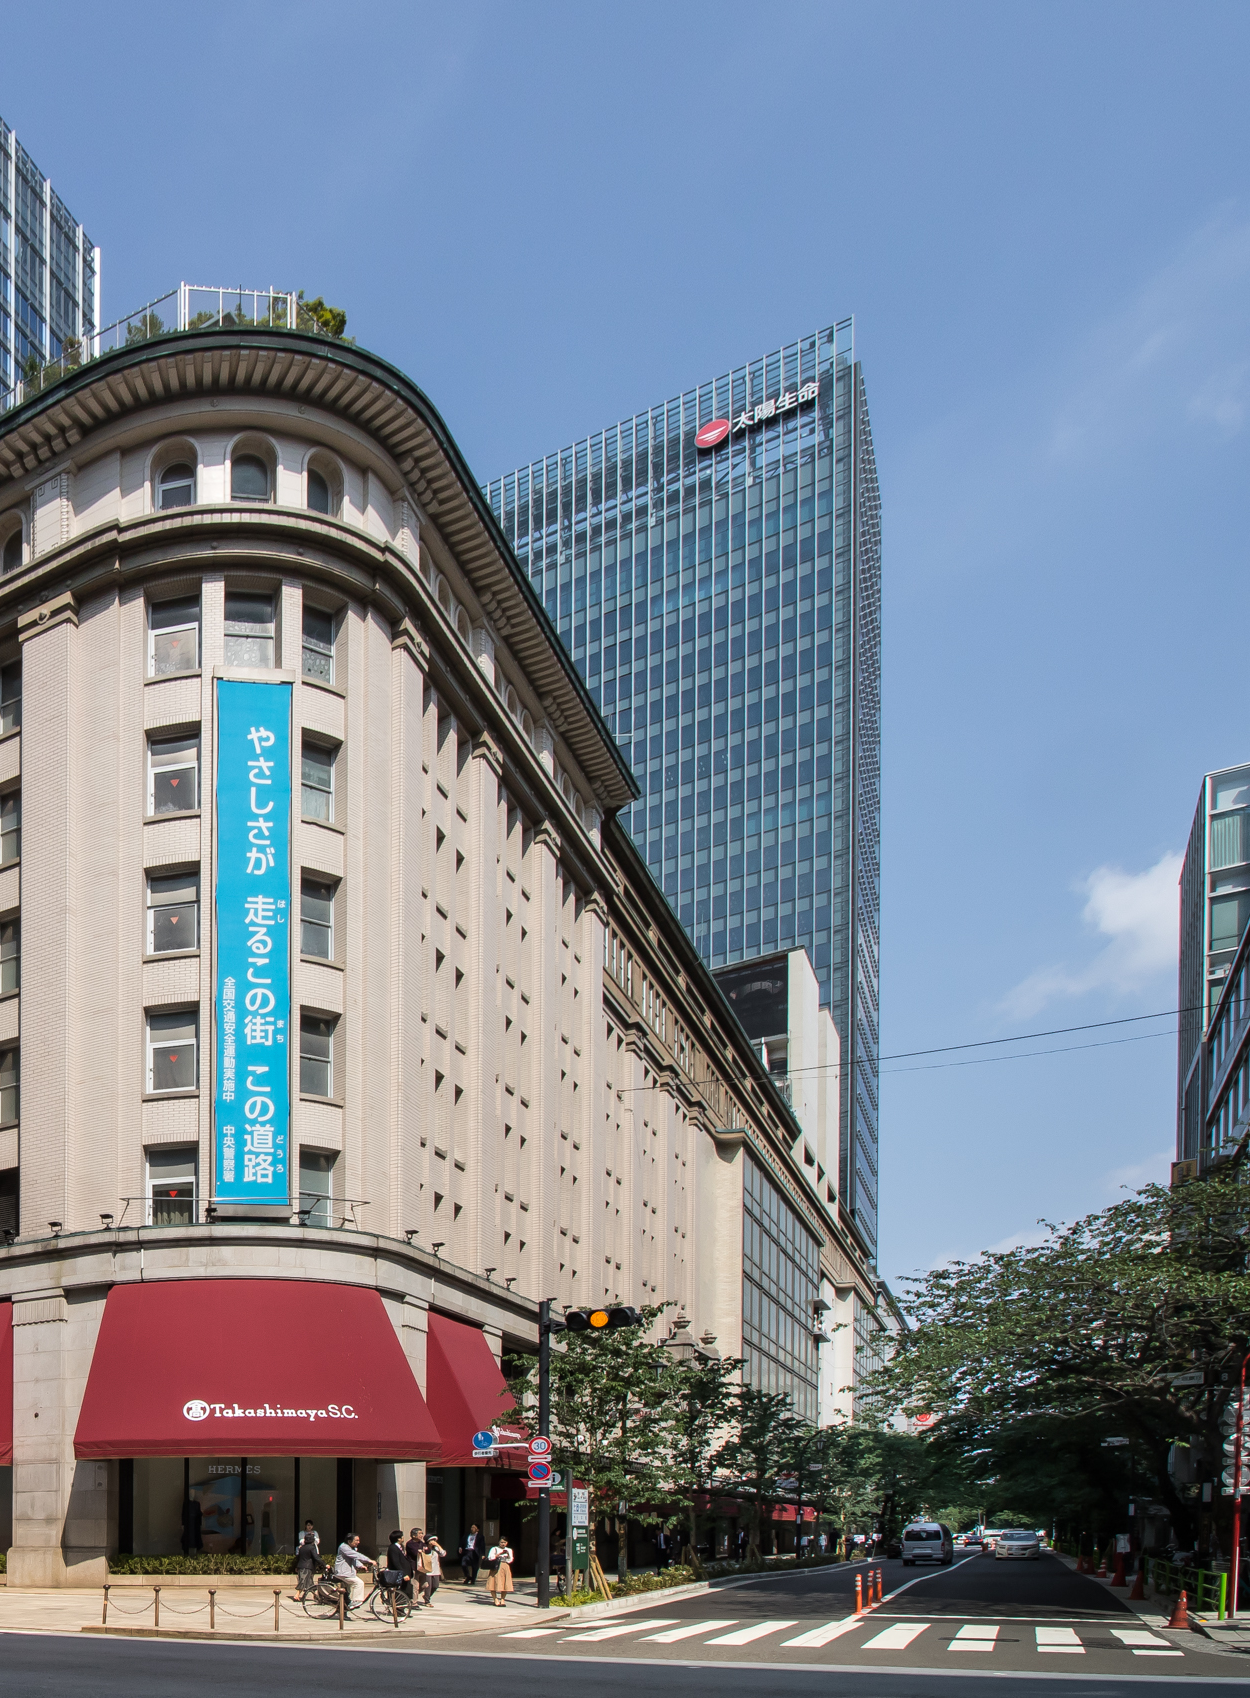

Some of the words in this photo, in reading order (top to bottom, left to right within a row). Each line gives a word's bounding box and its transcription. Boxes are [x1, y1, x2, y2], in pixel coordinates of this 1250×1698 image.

[732, 381, 820, 433] 太陽生命
[246, 726, 275, 876] やさしさが
[277, 899, 286, 923] はし
[244, 894, 276, 1046] 走るこの街
[222, 976, 236, 1103] 全国交通安全運動実施中
[276, 1019, 285, 1043] まち
[243, 1066, 275, 1184] この道路
[222, 1124, 236, 1183] 中央警察署
[276, 1135, 284, 1173] どうろ
[210, 1403, 327, 1422] Takashimaya
[328, 1404, 359, 1419] S.C.
[533, 1441, 547, 1450] 30
